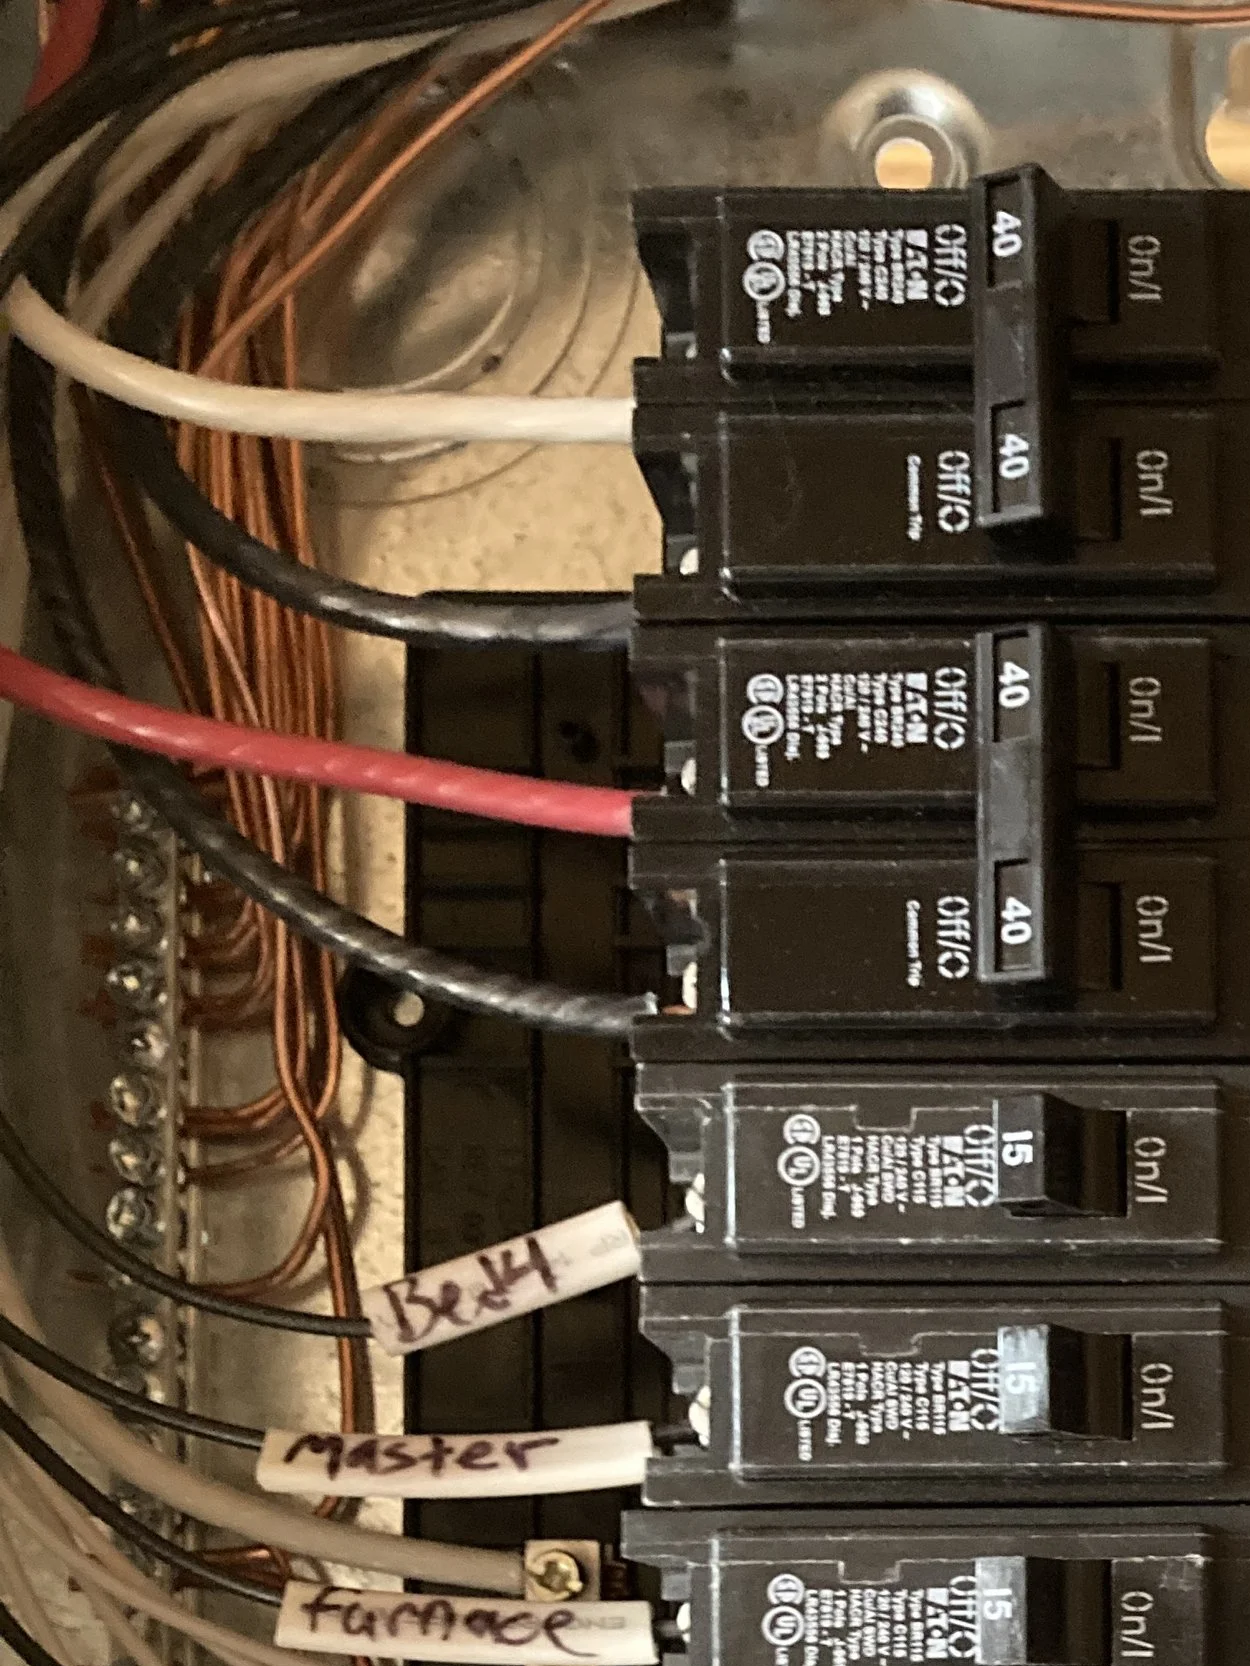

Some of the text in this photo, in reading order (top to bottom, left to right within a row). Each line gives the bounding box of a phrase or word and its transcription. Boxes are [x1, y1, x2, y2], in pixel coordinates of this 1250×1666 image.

[993, 211, 1022, 257] 40
[1000, 434, 1029, 478] 40
[999, 662, 1029, 707] 40
[1002, 897, 1032, 944] 40
[1002, 1130, 1034, 1166] 15
[1004, 1362, 1038, 1394] 15
[978, 1587, 1013, 1619] 15
